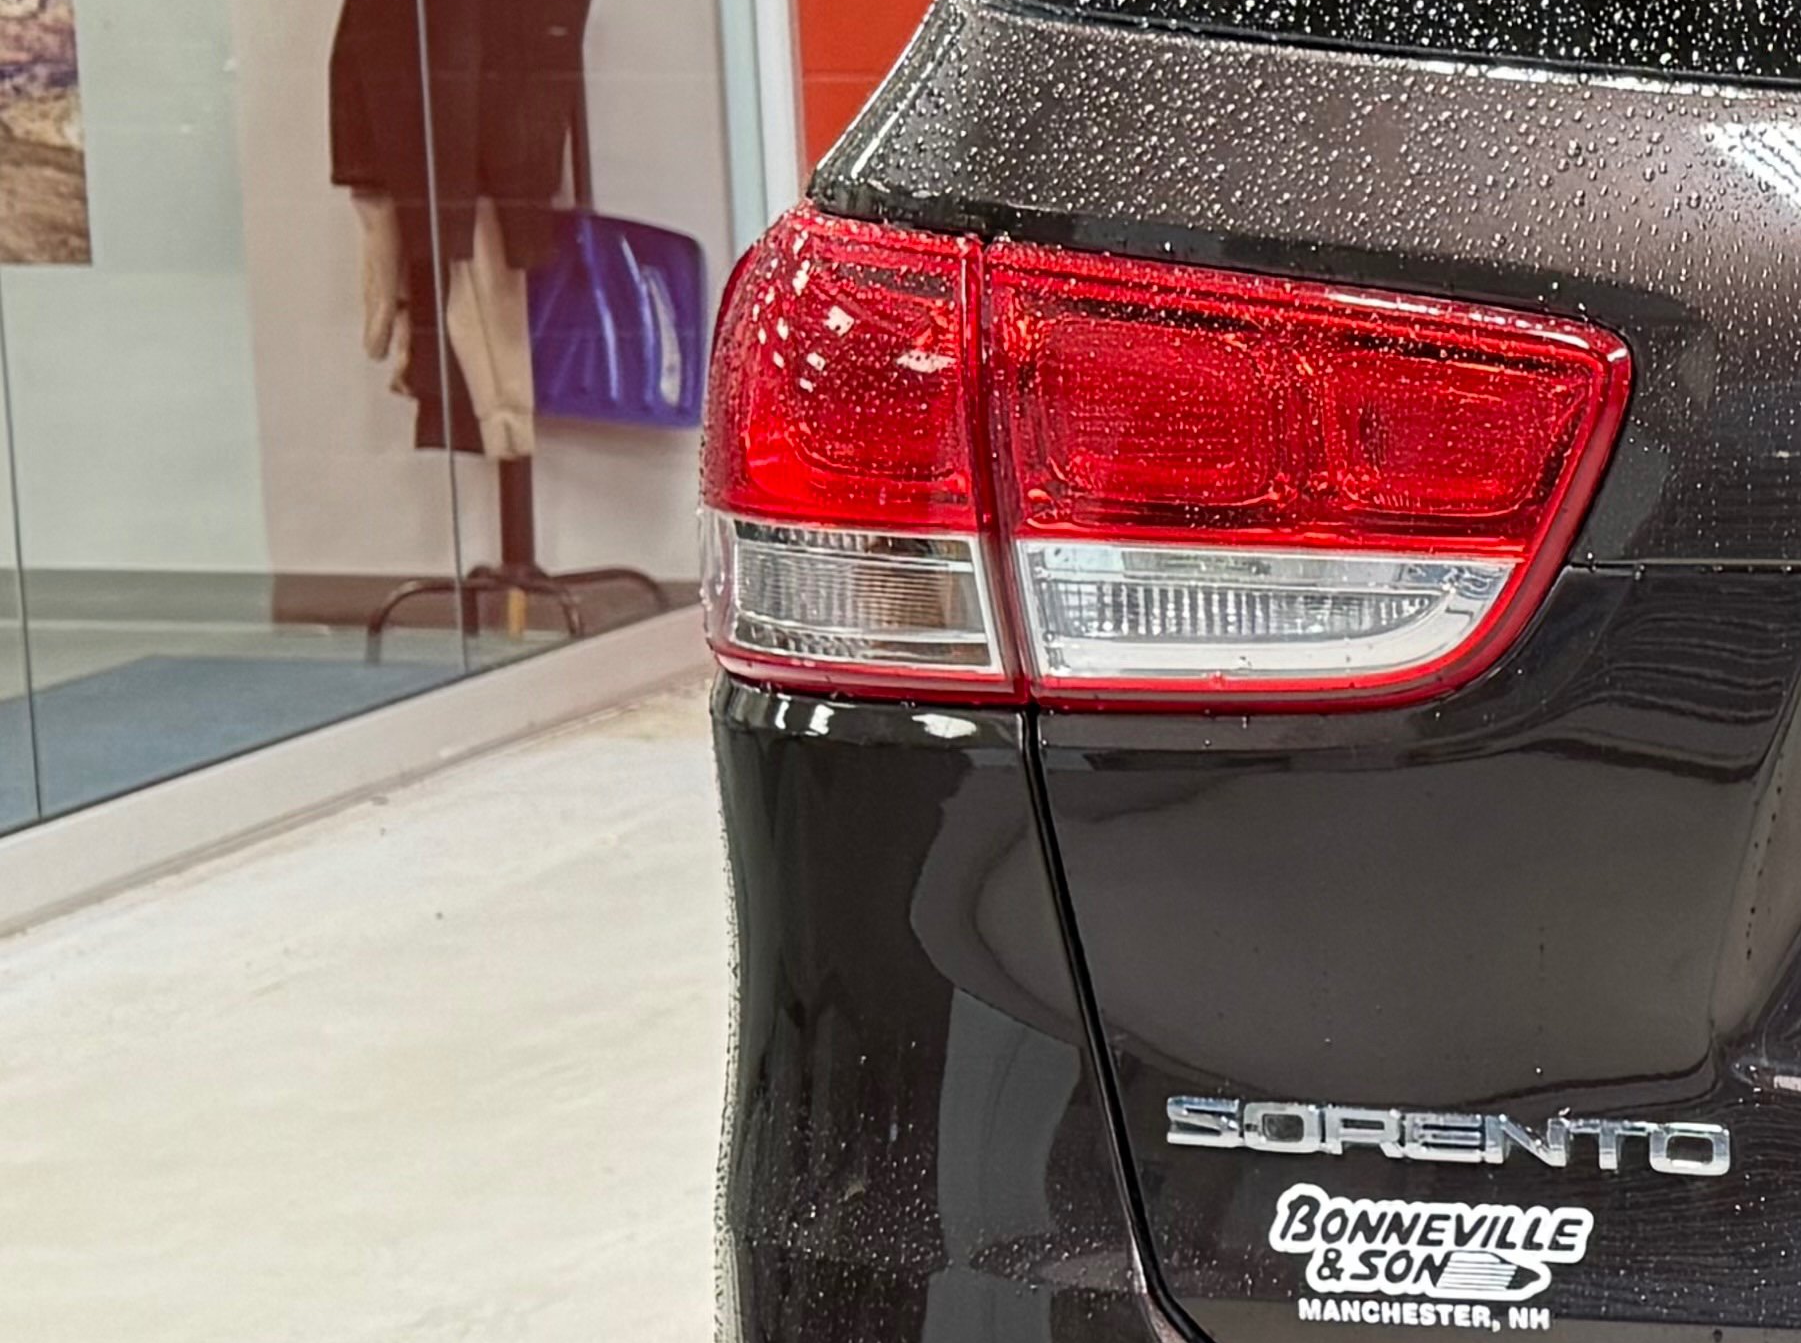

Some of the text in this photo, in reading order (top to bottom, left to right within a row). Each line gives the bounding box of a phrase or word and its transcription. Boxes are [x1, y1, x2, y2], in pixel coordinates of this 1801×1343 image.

[1166, 1095, 1732, 1177] SORENTO
[1280, 1194, 1584, 1252] BONNEVILLE
[1317, 1248, 1450, 1288] & SON
[1298, 1298, 1551, 1332] MANCHESTER, NH
